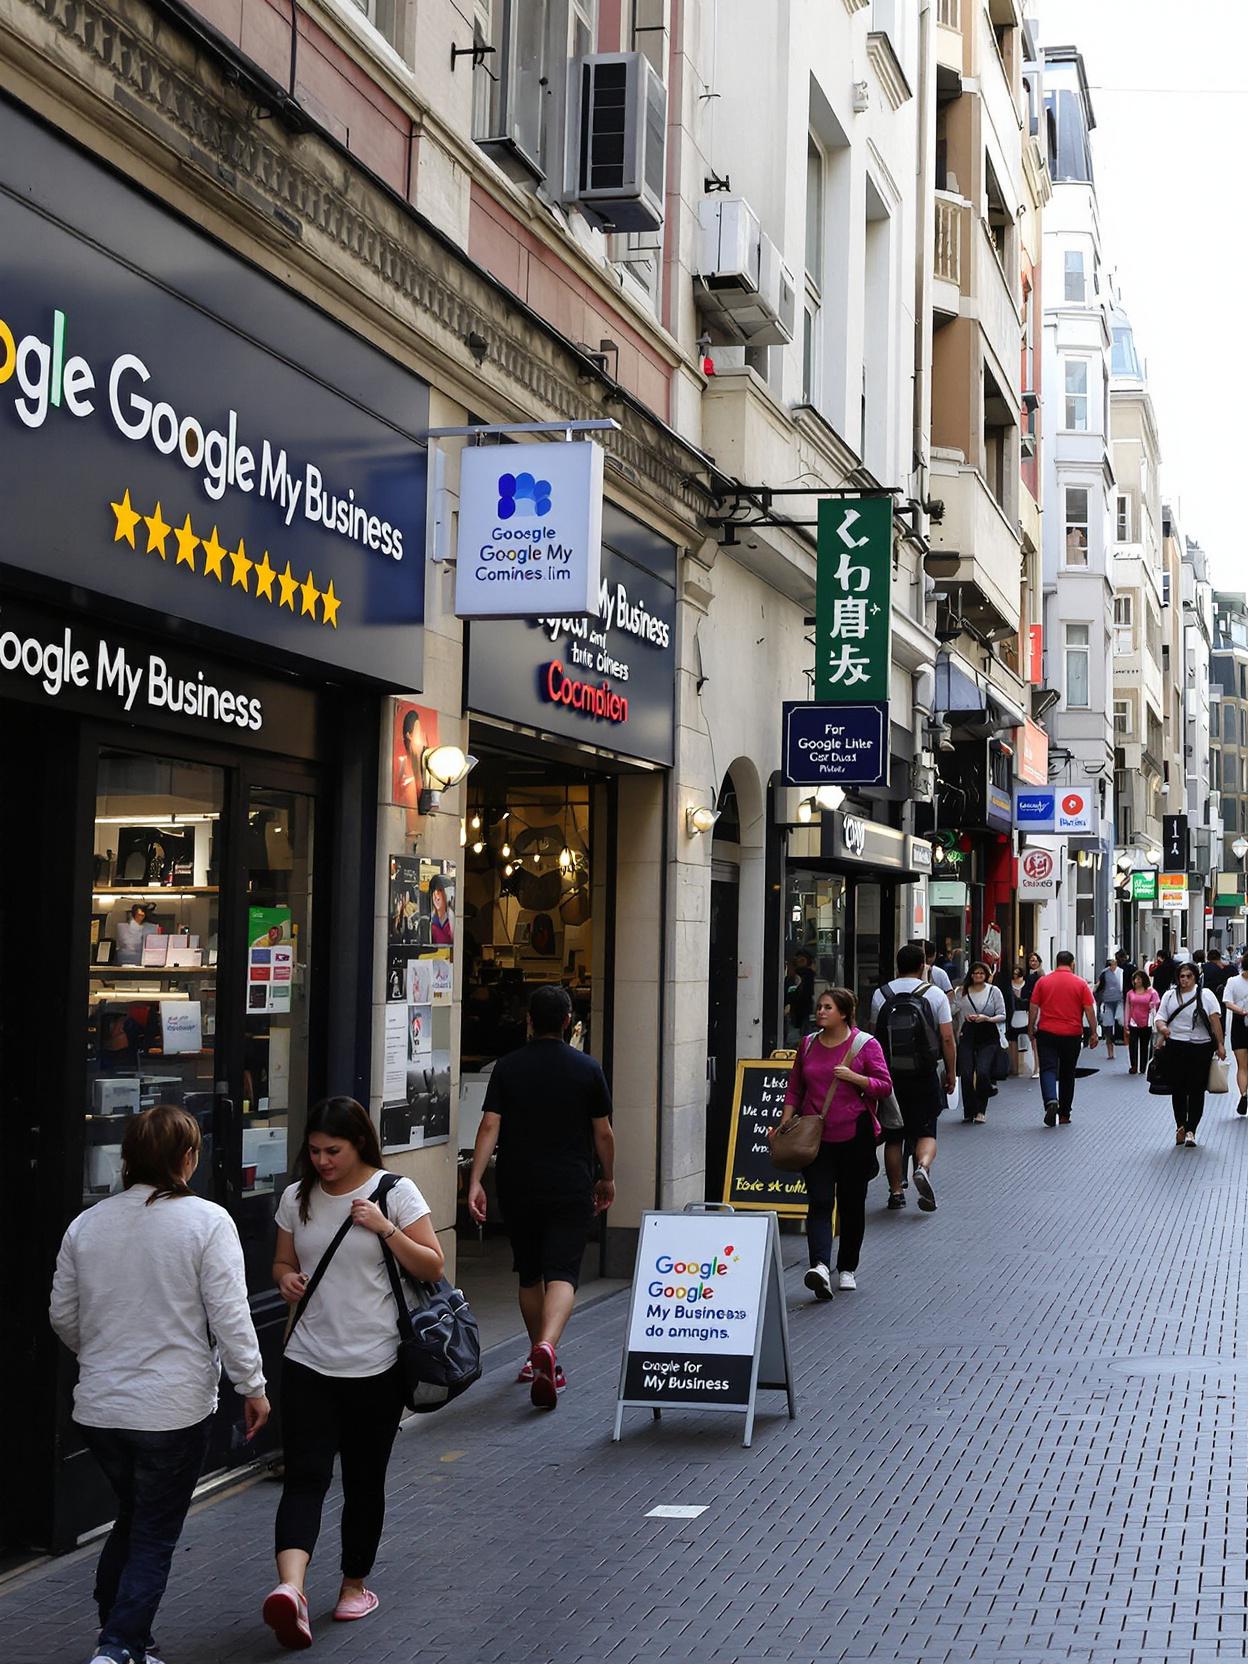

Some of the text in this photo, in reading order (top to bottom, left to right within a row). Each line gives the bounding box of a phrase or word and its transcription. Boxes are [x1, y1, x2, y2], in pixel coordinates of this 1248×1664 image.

[109, 354, 255, 500] Google
[260, 440, 302, 525] My
[305, 464, 403, 560] Business
[480, 544, 573, 564] Google My
[617, 583, 670, 648] Business
[97, 640, 143, 711] My
[148, 655, 262, 730] Business
[825, 724, 845, 735] For
[656, 1256, 728, 1280] Google
[648, 1281, 714, 1303] Google
[646, 1304, 670, 1321] My
[646, 1324, 664, 1337] do
[684, 1361, 702, 1373] for
[644, 1375, 729, 1391] My Business
